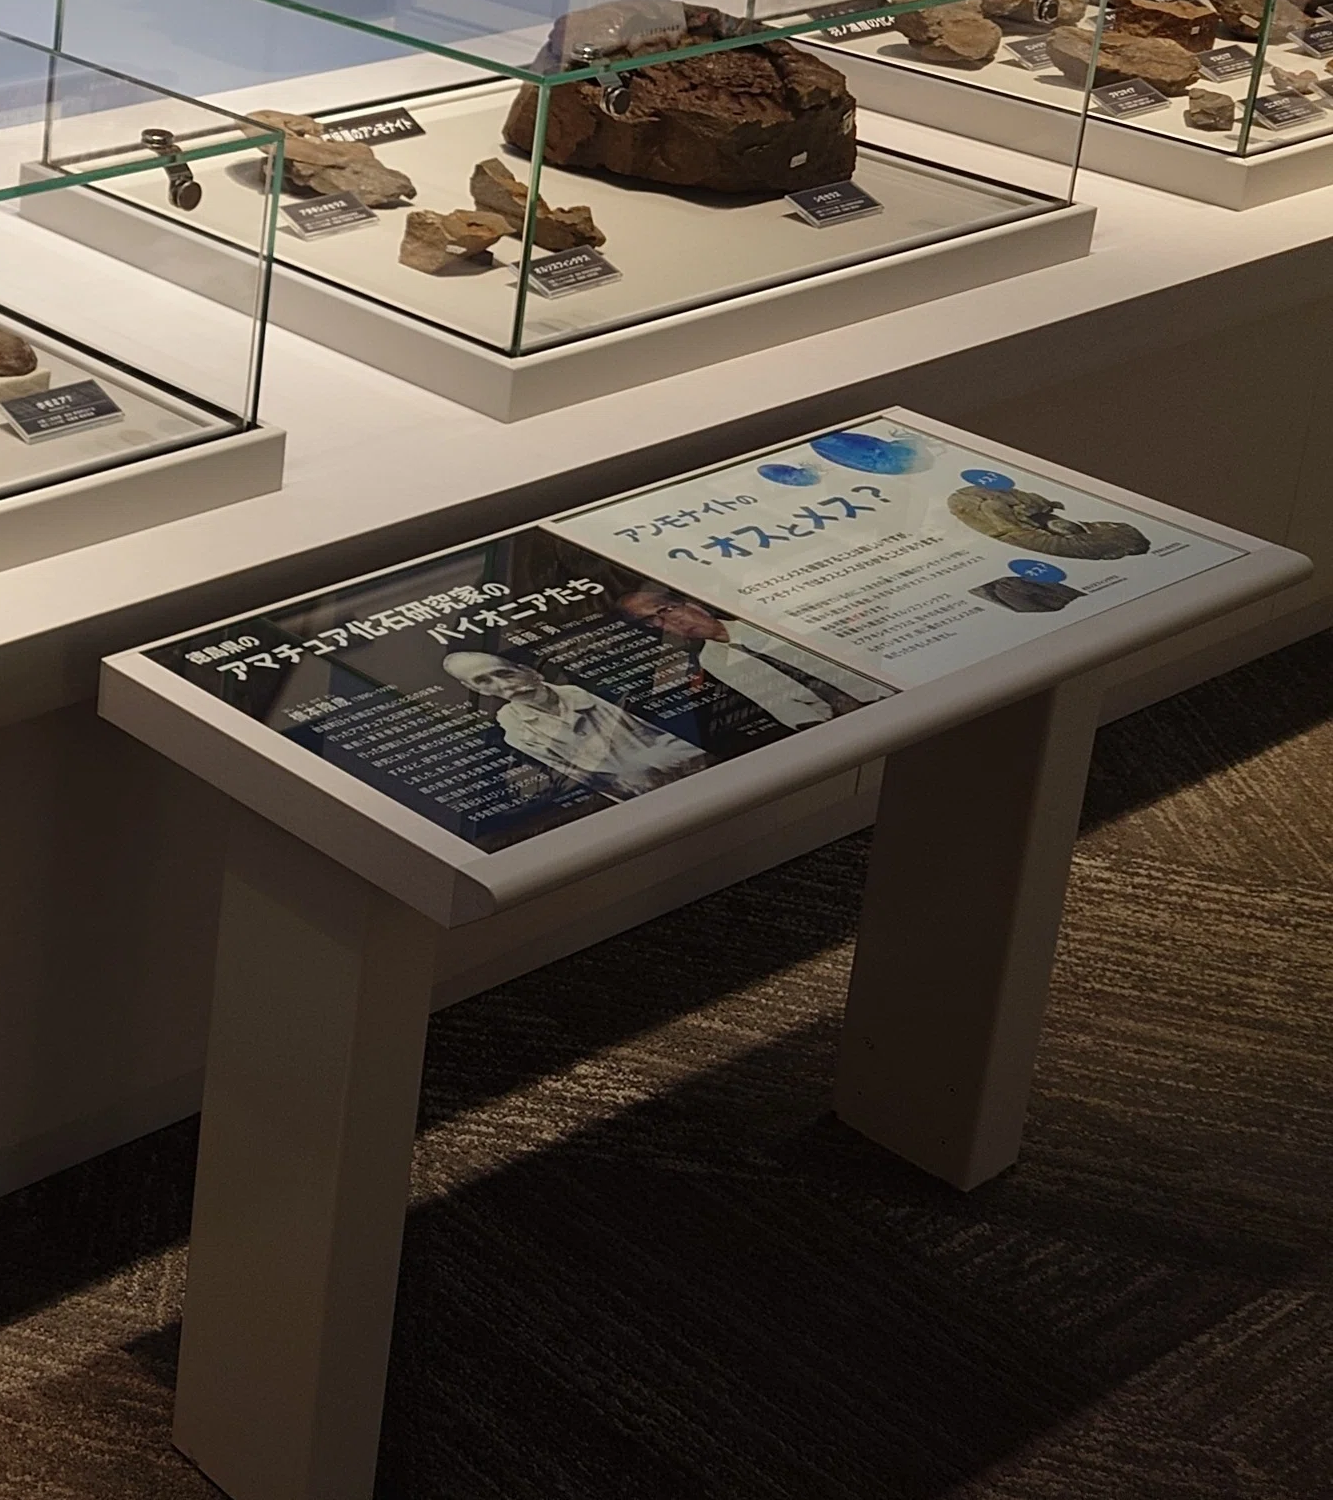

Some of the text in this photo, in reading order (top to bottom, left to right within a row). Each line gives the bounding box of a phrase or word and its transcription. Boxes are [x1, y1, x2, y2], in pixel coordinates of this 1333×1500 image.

[613, 494, 759, 543] アンモナイトの
[217, 581, 510, 682] アマチュア化石研究家の
[426, 576, 606, 646] パイオニアたち
[185, 636, 261, 664] 徳島県の
